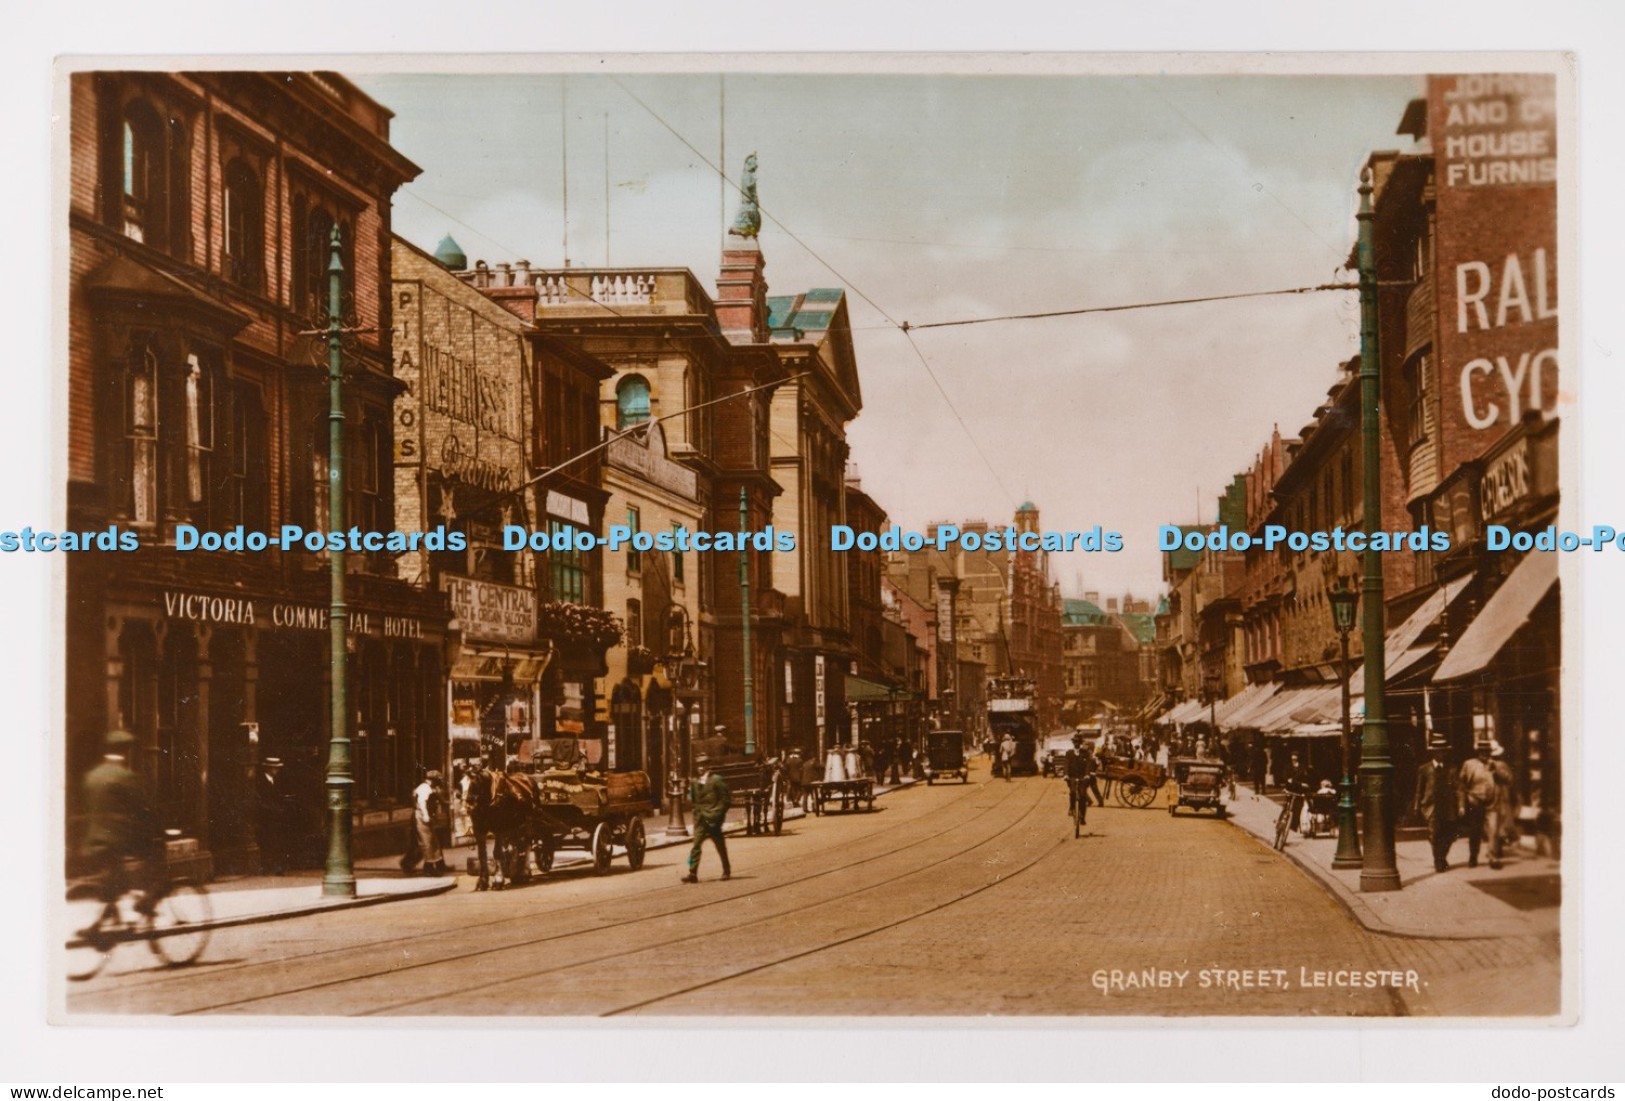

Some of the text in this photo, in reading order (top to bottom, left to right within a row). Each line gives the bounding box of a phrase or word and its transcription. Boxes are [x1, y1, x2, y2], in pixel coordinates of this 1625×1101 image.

[1446, 100, 1509, 126] AND
[1446, 131, 1550, 159] HOUSE
[446, 578, 472, 605] THE
[164, 592, 255, 625] VICTORIA
[272, 604, 373, 635] COMMEIAL
[384, 616, 425, 640] HOTEL
